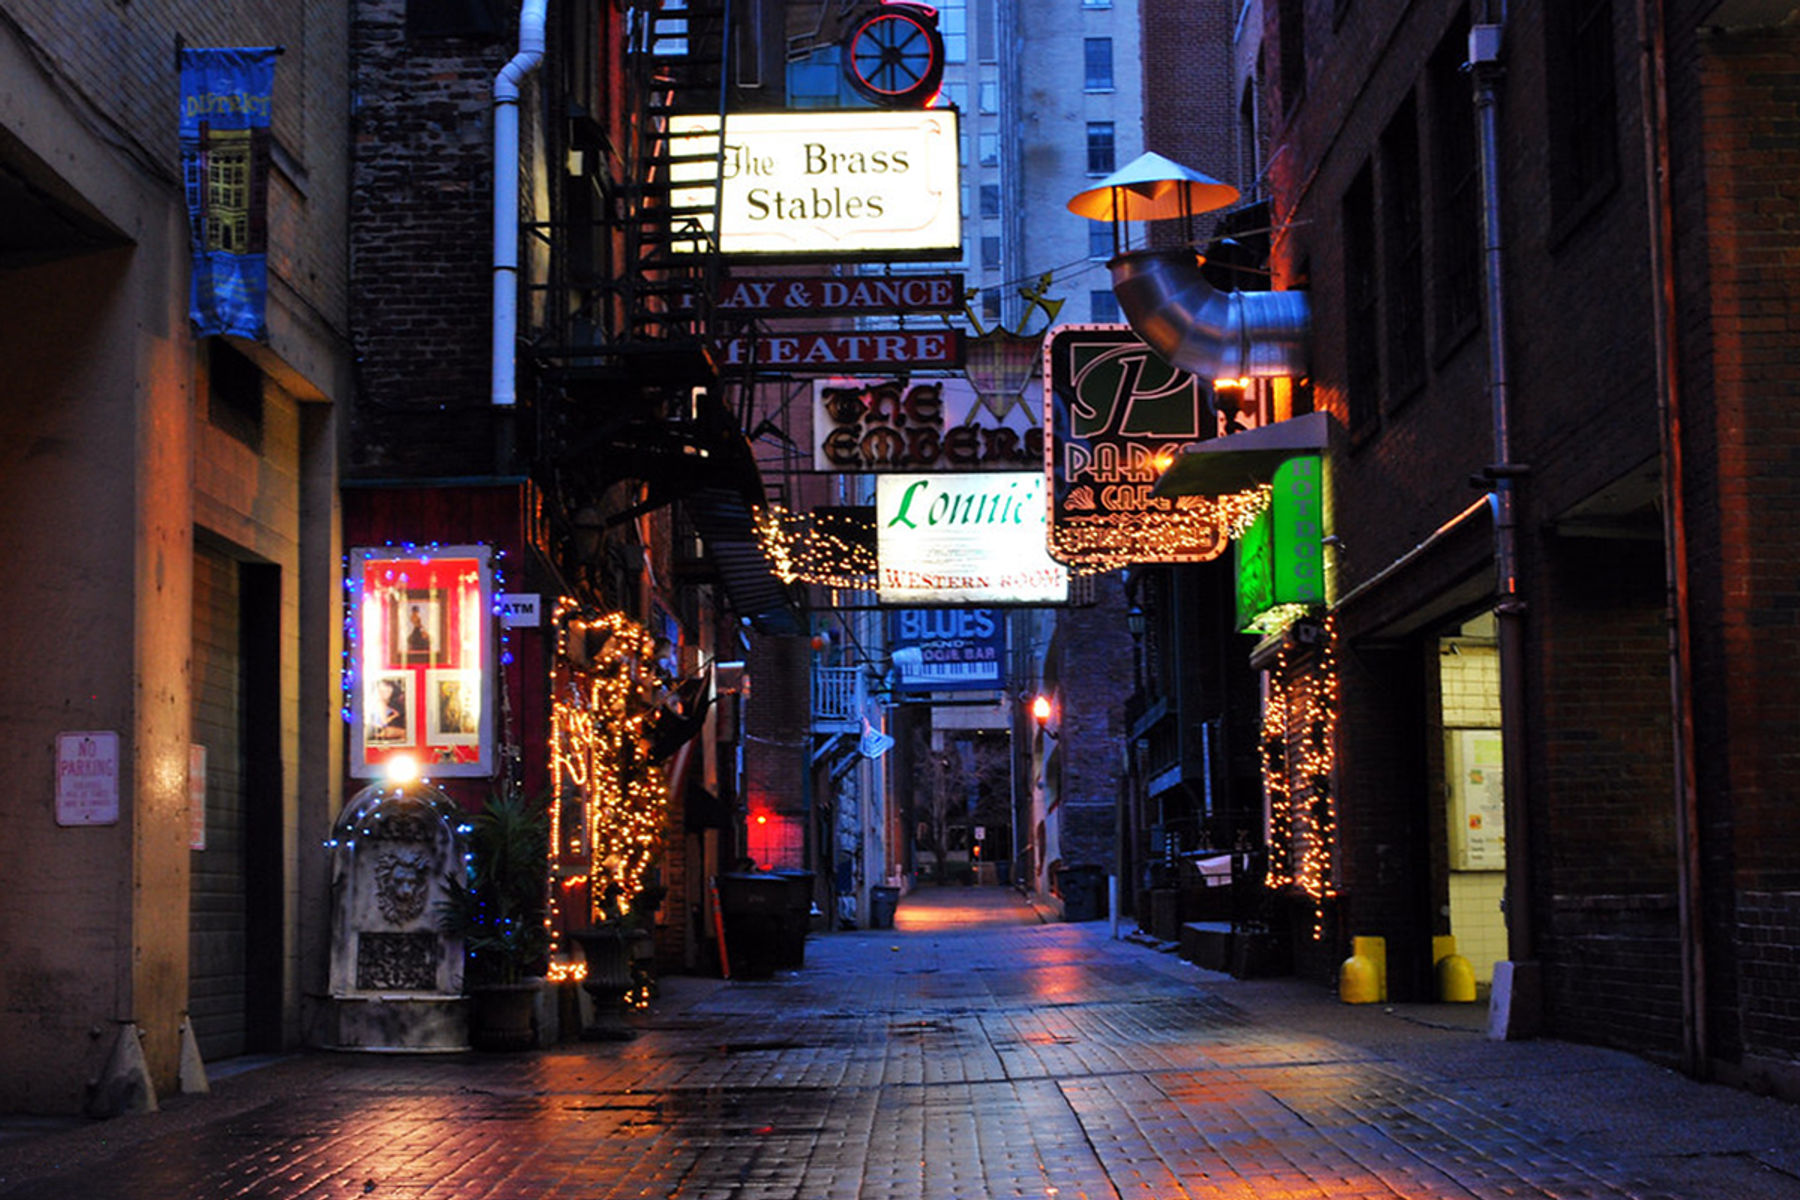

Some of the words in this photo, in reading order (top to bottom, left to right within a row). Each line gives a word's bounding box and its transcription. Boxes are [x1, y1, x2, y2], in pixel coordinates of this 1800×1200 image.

[187, 92, 271, 117] DISTRICT
[722, 143, 774, 179] The
[803, 142, 910, 175] Brass
[747, 187, 885, 221] Stables
[783, 281, 812, 308] &
[821, 280, 953, 308] DANCE
[885, 567, 989, 590] WESTERN
[502, 603, 533, 614] ATM
[901, 609, 995, 639] BLUES
[78, 741, 97, 757] NO
[61, 759, 113, 776] PARKING
